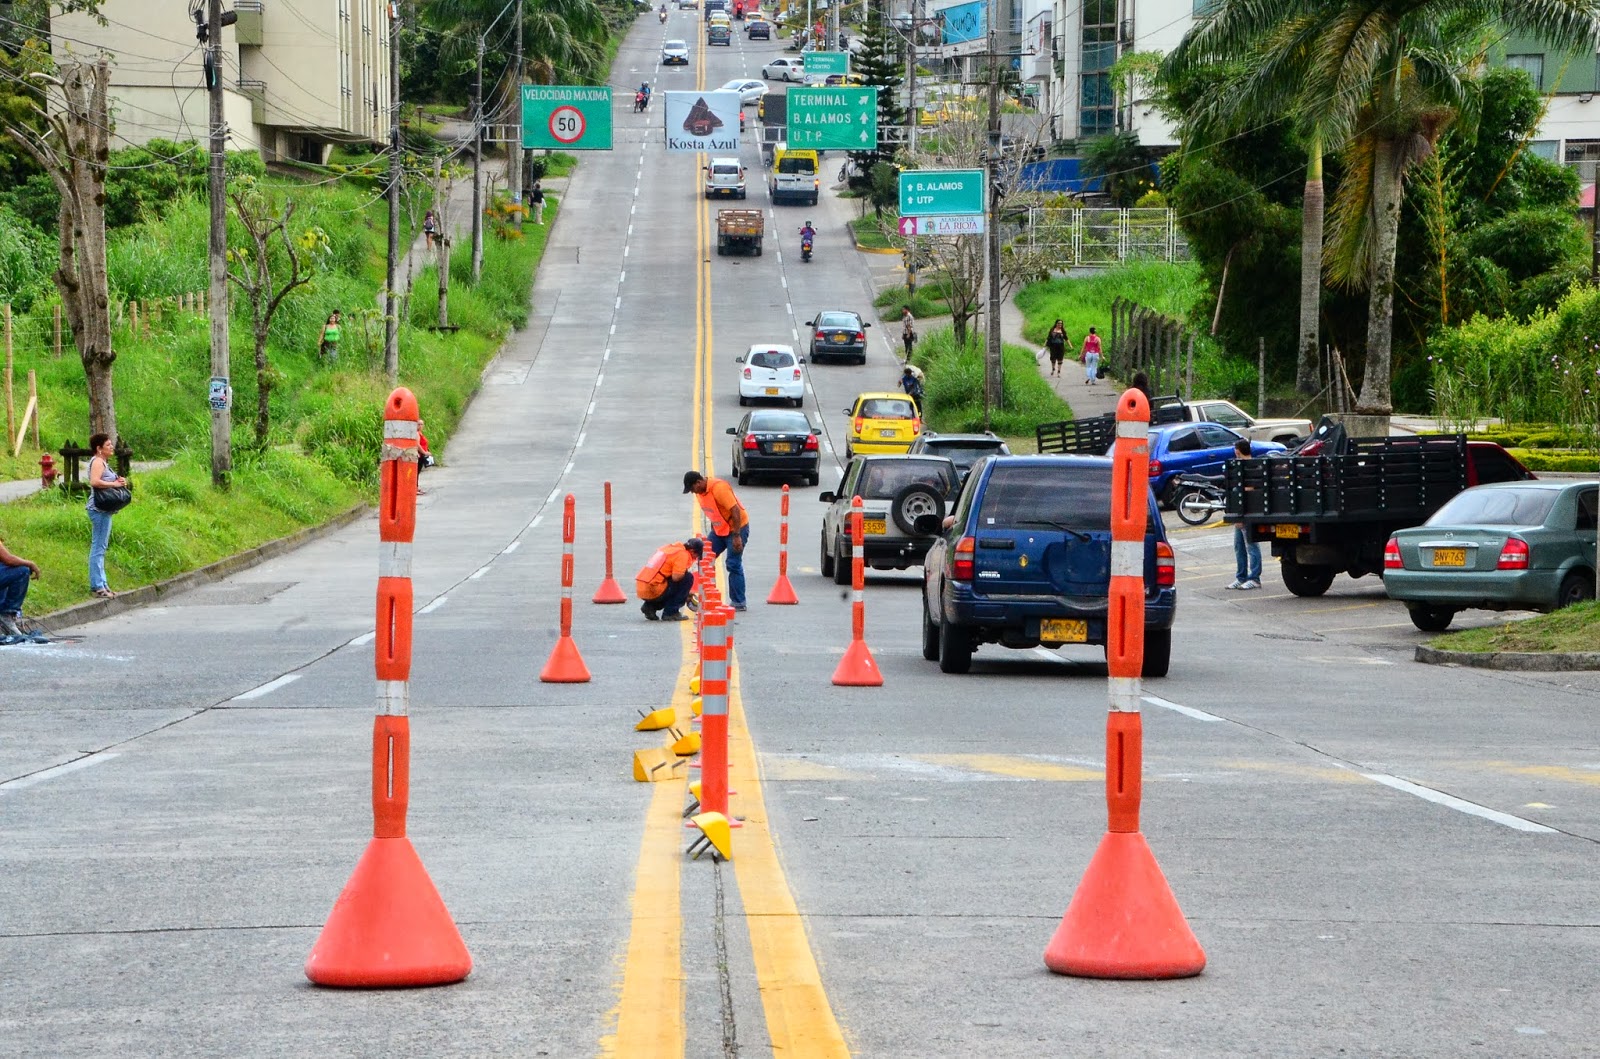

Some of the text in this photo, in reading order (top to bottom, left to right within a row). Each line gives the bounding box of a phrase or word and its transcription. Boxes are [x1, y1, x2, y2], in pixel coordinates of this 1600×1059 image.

[524, 89, 609, 101] VELOCIDAD MAXIMA
[794, 95, 848, 106] TERMINAL
[804, 113, 852, 124] ALAMOS
[558, 117, 576, 132] 50
[669, 137, 737, 150] Kosta Azul
[916, 182, 963, 191] B. ALAMOS
[916, 196, 934, 204] UTP
[939, 221, 978, 230] LA RIOJA
